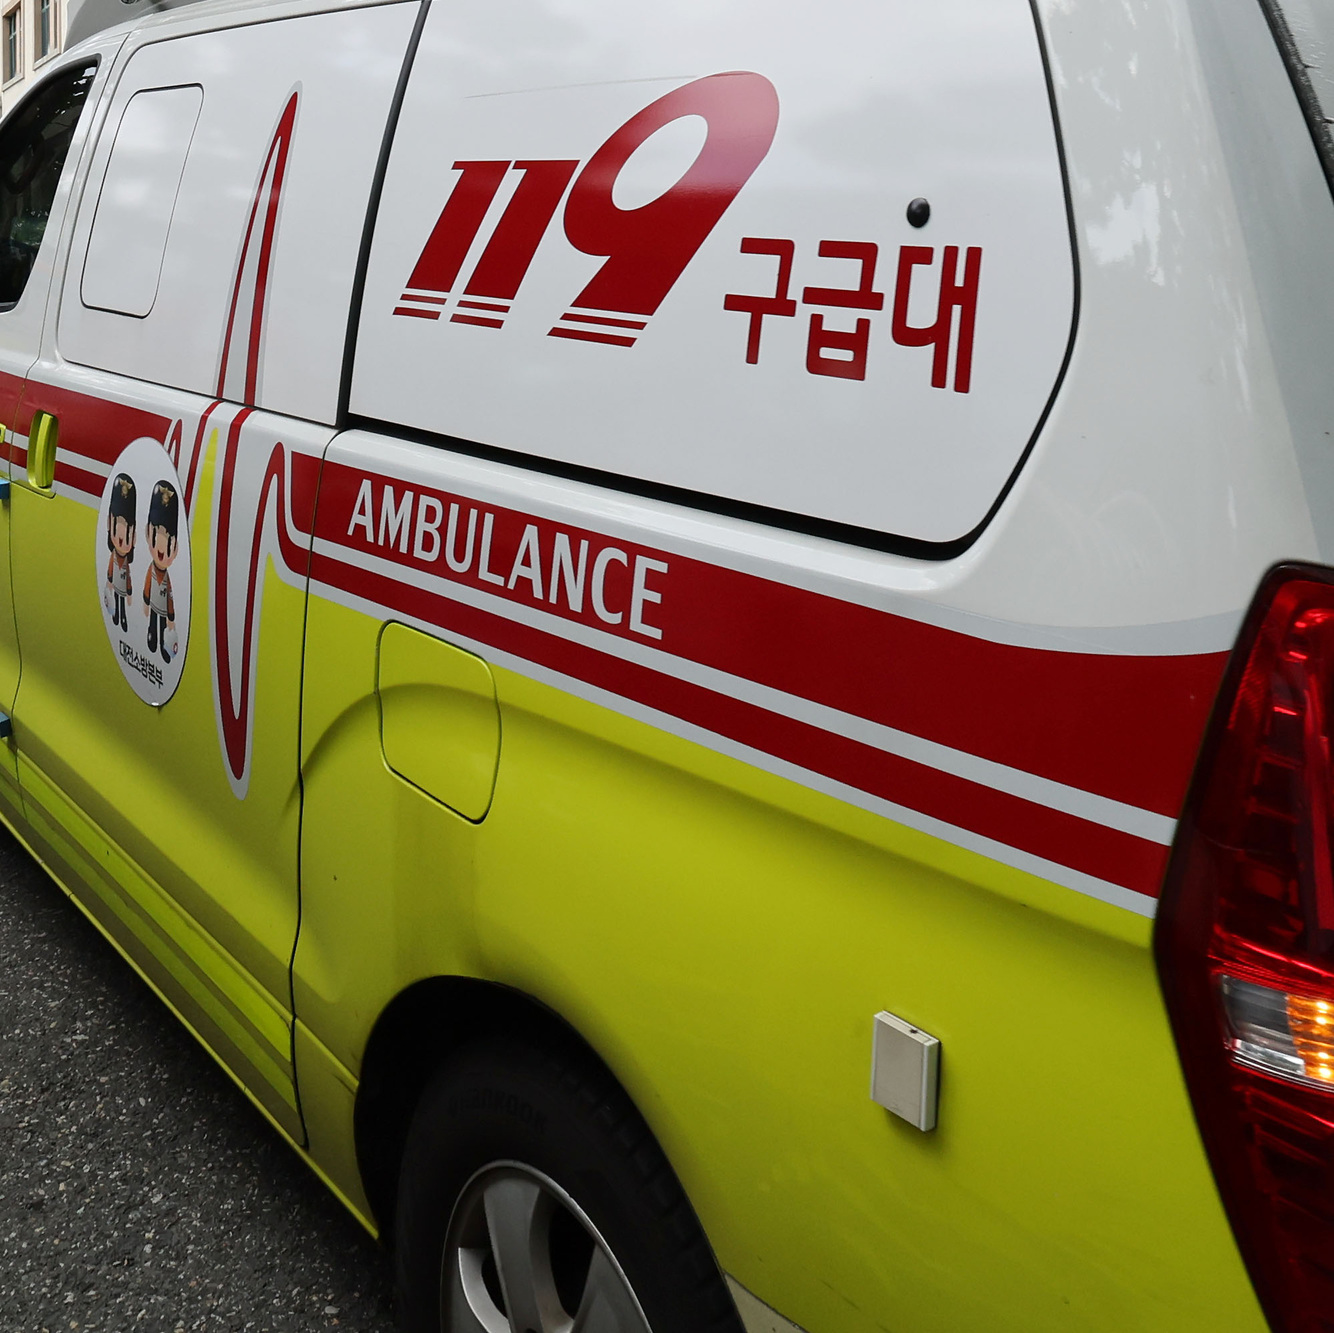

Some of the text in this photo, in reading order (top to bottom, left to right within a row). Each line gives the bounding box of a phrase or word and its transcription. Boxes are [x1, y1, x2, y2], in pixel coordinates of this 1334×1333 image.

[391, 69, 983, 394] 119 구급대
[346, 479, 668, 640] AMBULANCE
[119, 639, 164, 689] 대전소방본부
